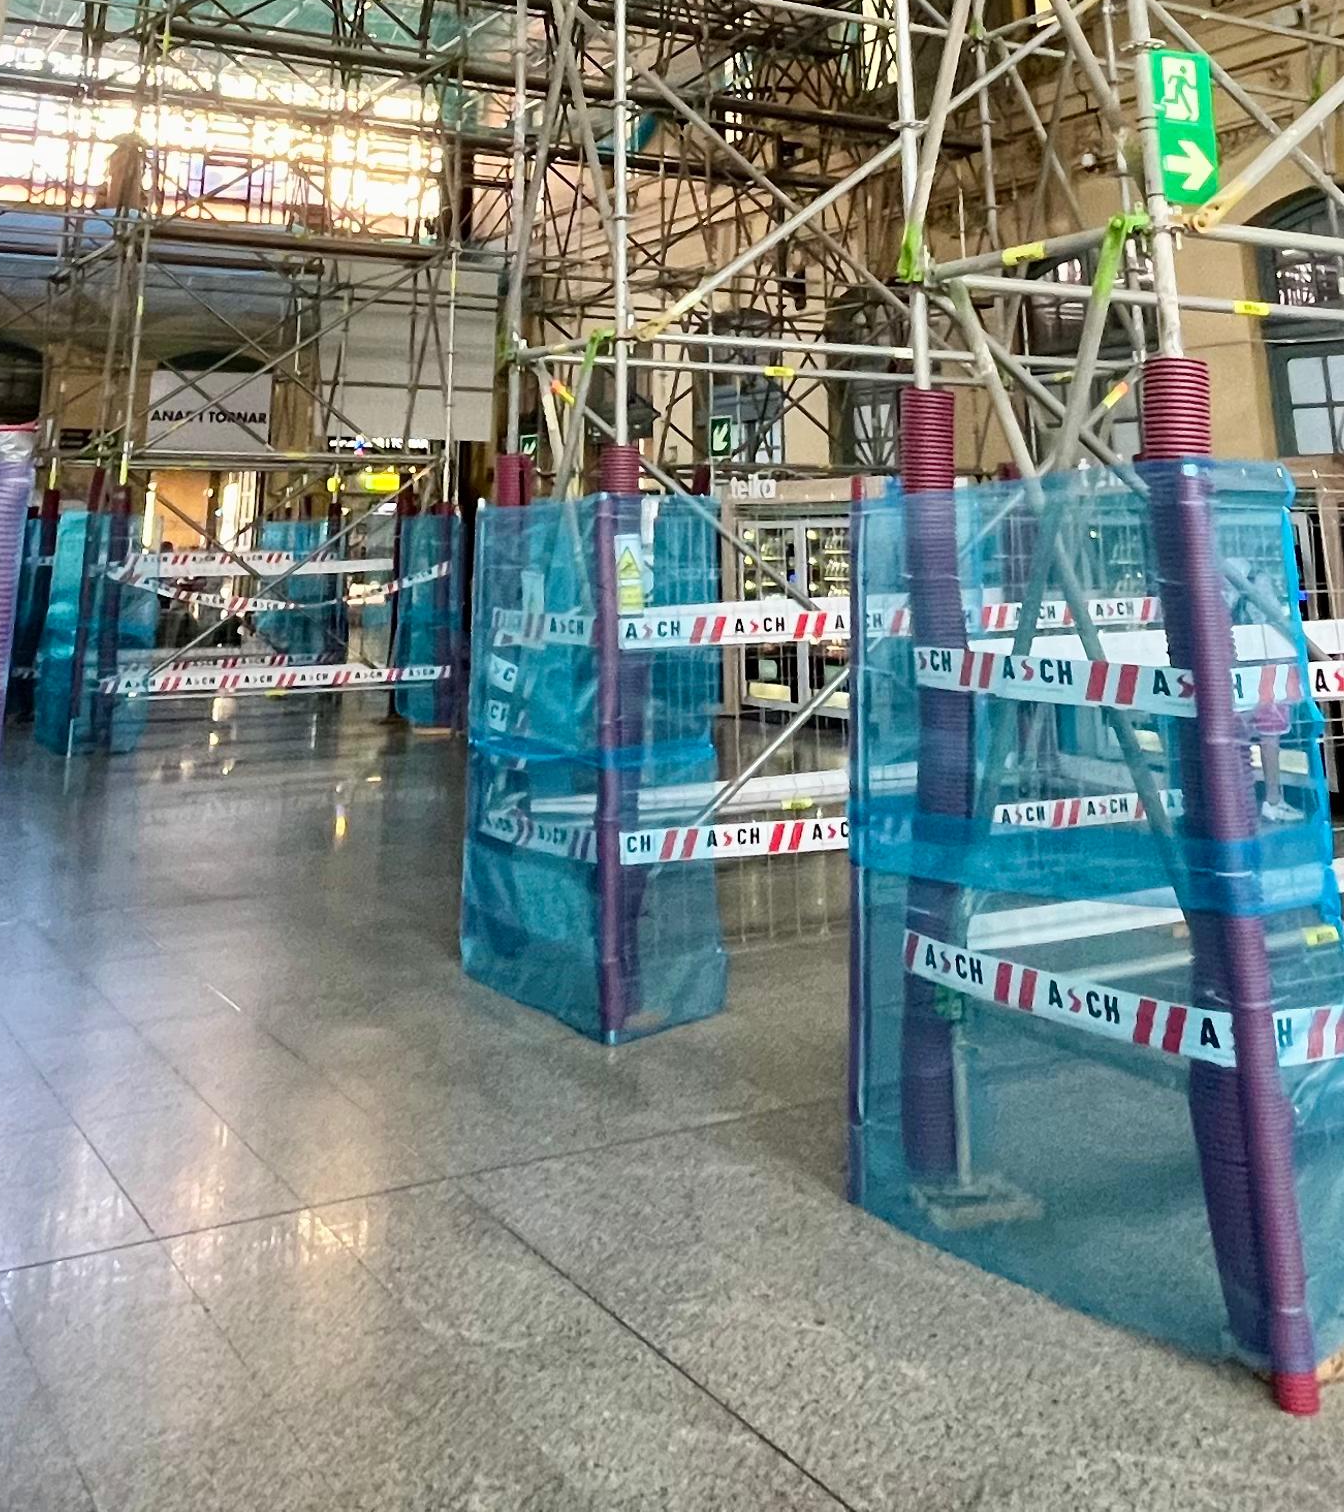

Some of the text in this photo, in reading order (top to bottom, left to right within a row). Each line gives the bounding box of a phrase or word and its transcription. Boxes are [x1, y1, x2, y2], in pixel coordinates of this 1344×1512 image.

[1095, 602, 1135, 618] ASCH
[625, 621, 681, 640] ASCH
[735, 617, 785, 634] ASCH
[919, 650, 952, 672] SCH
[1002, 659, 1073, 685] ASCH
[1002, 797, 1129, 825] ASCH ASCH
[706, 827, 760, 848] ASCH
[813, 821, 849, 841] ASC
[925, 943, 983, 986] ASCH
[1048, 980, 1120, 1024] ASCH
